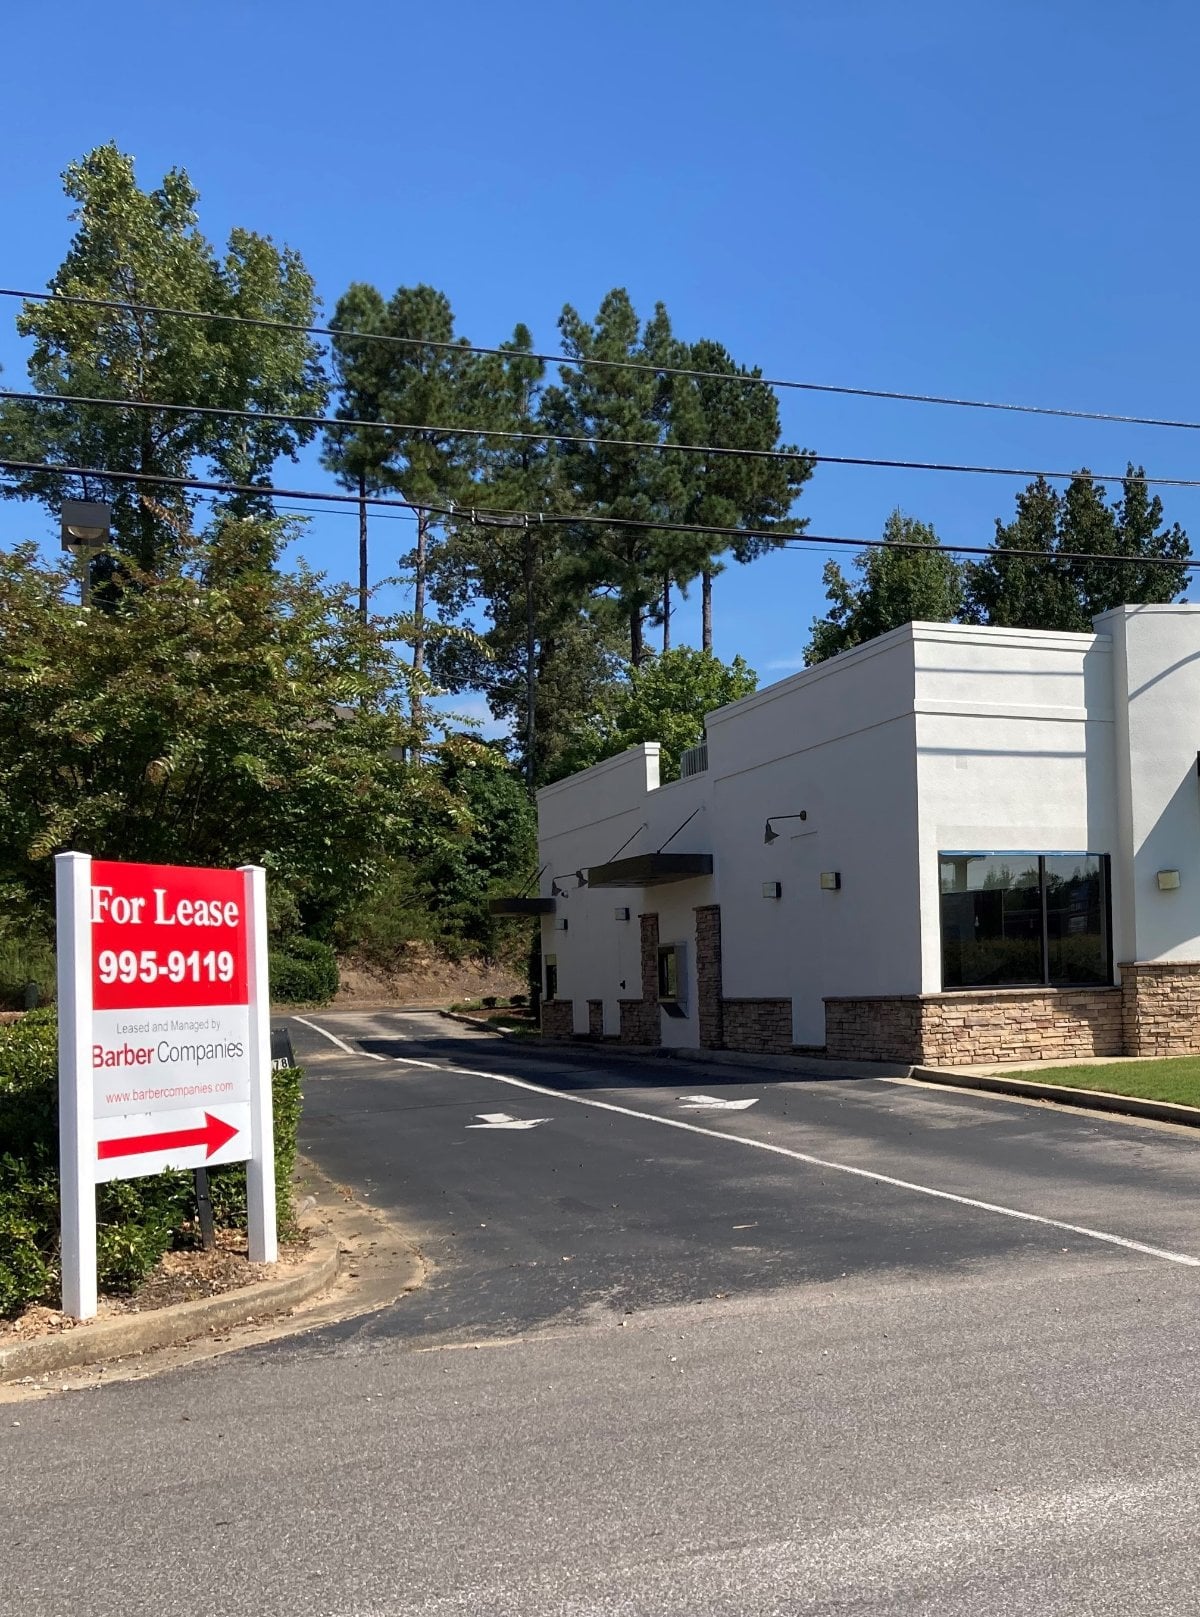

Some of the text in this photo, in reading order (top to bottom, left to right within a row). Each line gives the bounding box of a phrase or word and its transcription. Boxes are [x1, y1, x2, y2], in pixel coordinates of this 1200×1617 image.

[91, 885, 240, 928] For Lease
[98, 950, 234, 984] 995-9119
[116, 1018, 221, 1034] Leased and Managed by
[92, 1038, 244, 1068] Barber Companies
[106, 1080, 234, 1104] www.barbercompanies.com
